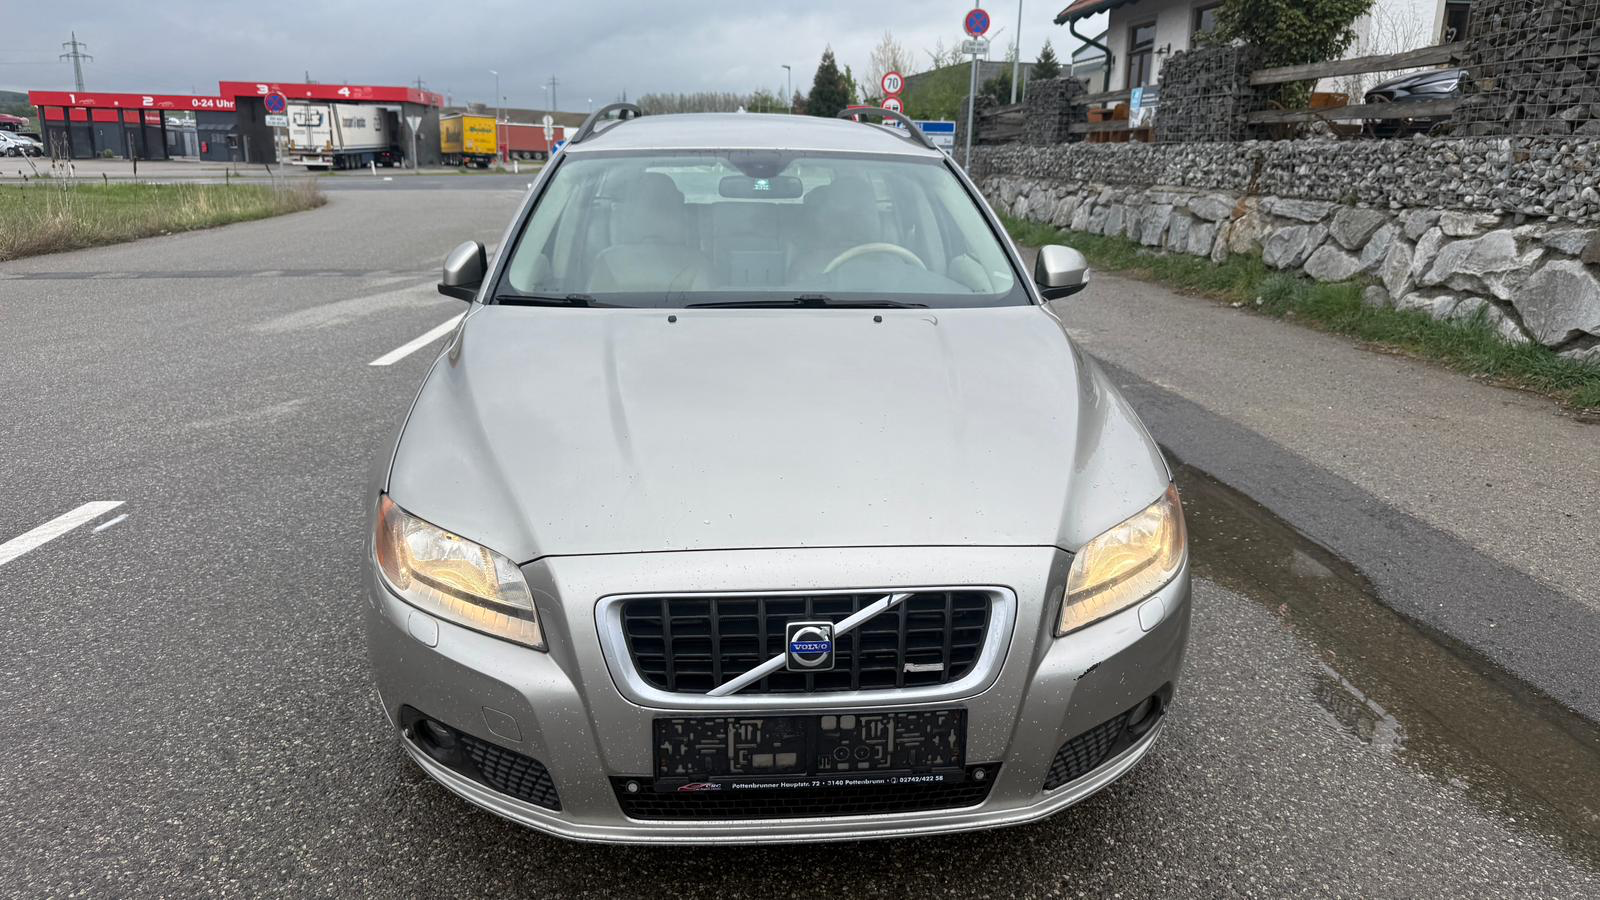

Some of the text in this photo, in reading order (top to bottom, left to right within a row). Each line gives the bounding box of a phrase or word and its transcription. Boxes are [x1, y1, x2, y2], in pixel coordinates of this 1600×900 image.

[887, 77, 899, 90] 70
[255, 84, 269, 95] 3
[337, 86, 351, 97] 4
[69, 94, 76, 104] 1
[142, 96, 154, 106] 2
[191, 98, 235, 108] 0-24 Uhr
[780, 781, 810, 789] Hauptstr.
